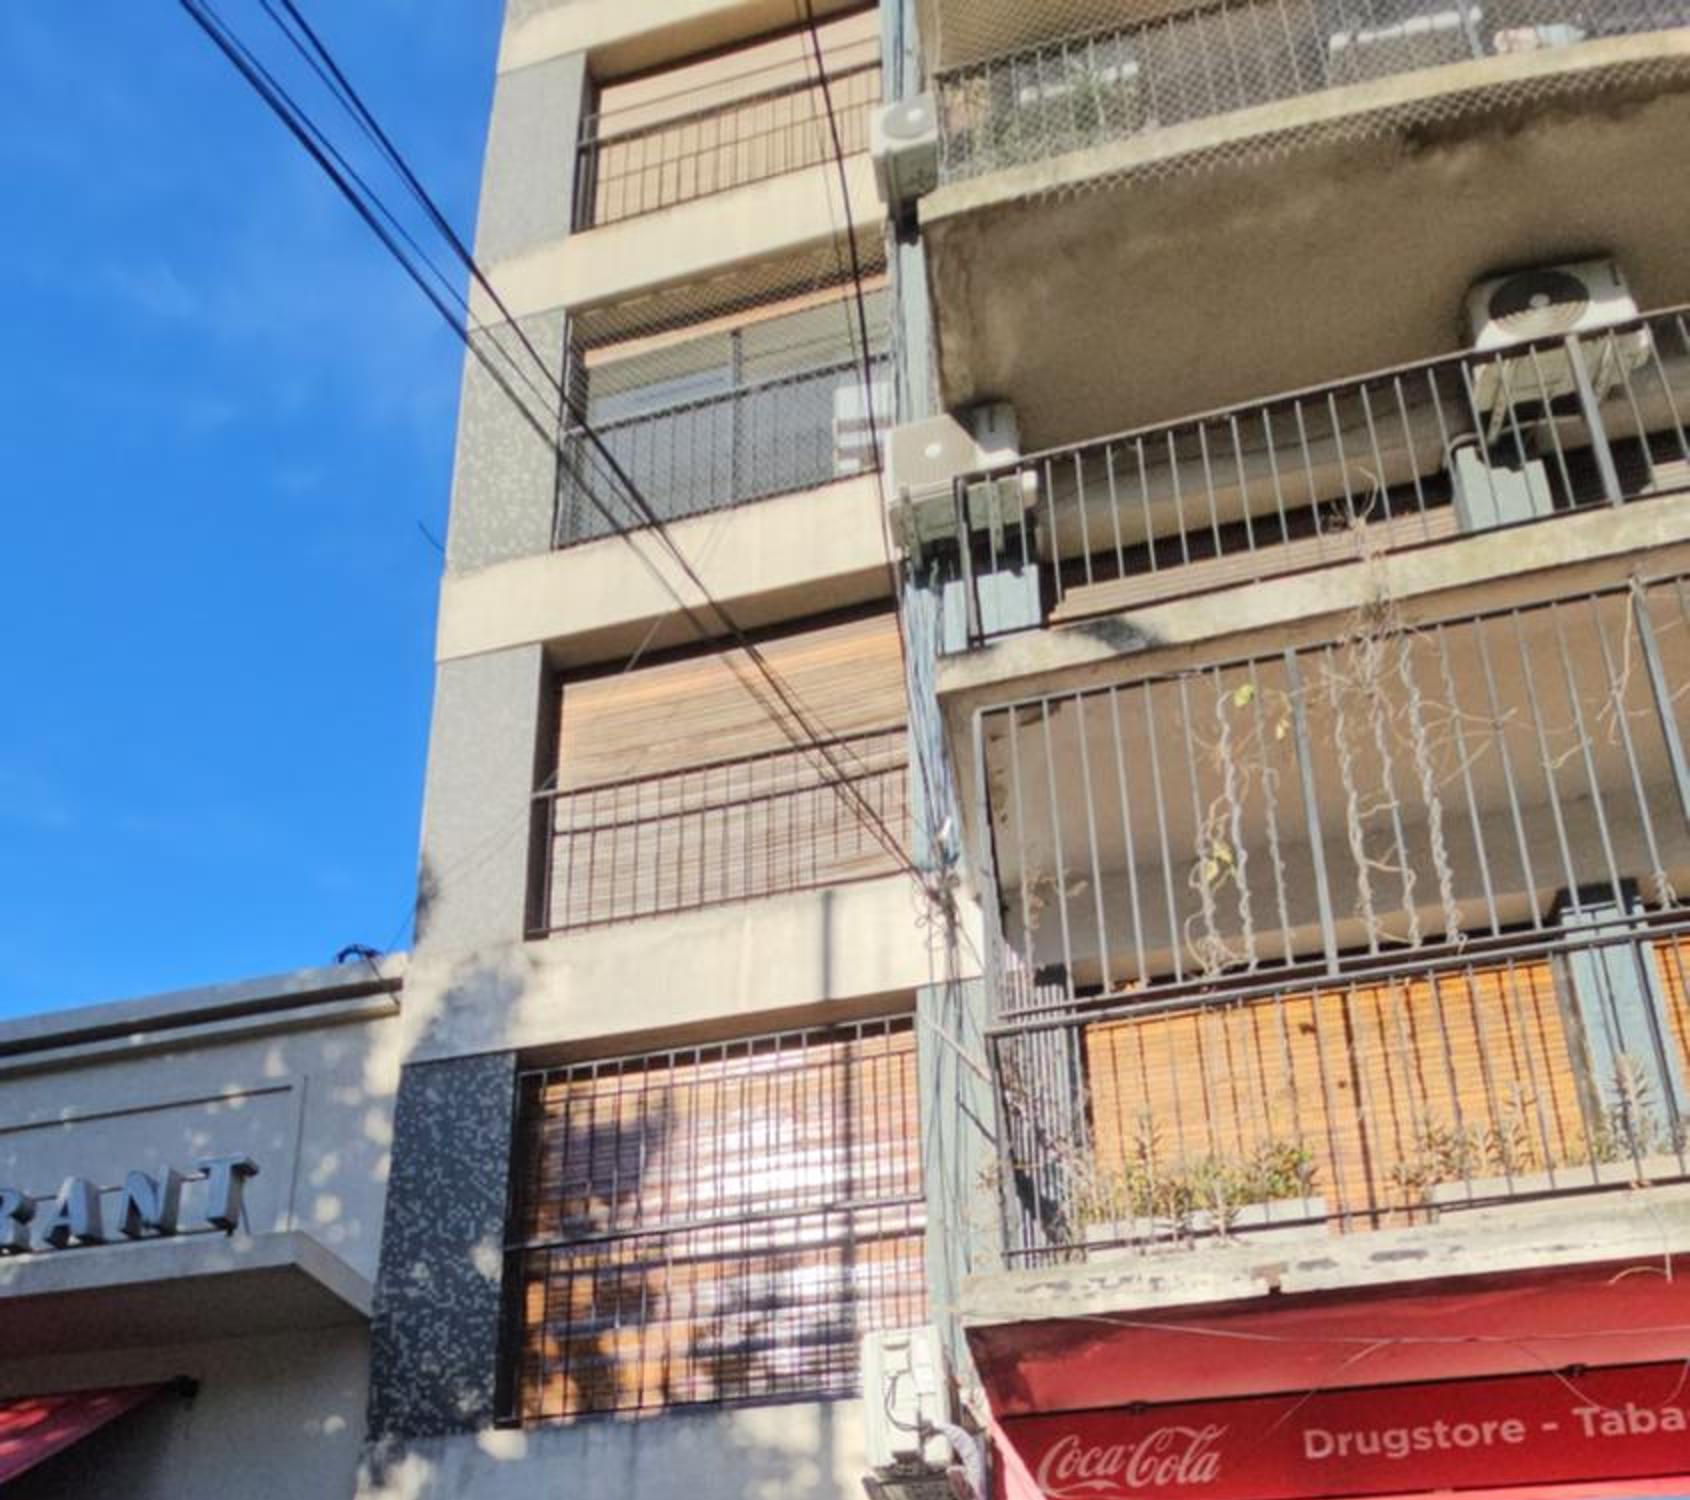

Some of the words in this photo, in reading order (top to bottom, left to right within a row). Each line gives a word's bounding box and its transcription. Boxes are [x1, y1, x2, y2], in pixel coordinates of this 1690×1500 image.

[1041, 1423, 1230, 1500] Coca-Cola
[1303, 1418, 1527, 1459] Drugstore
[1571, 1402, 1690, 1437] Taba
